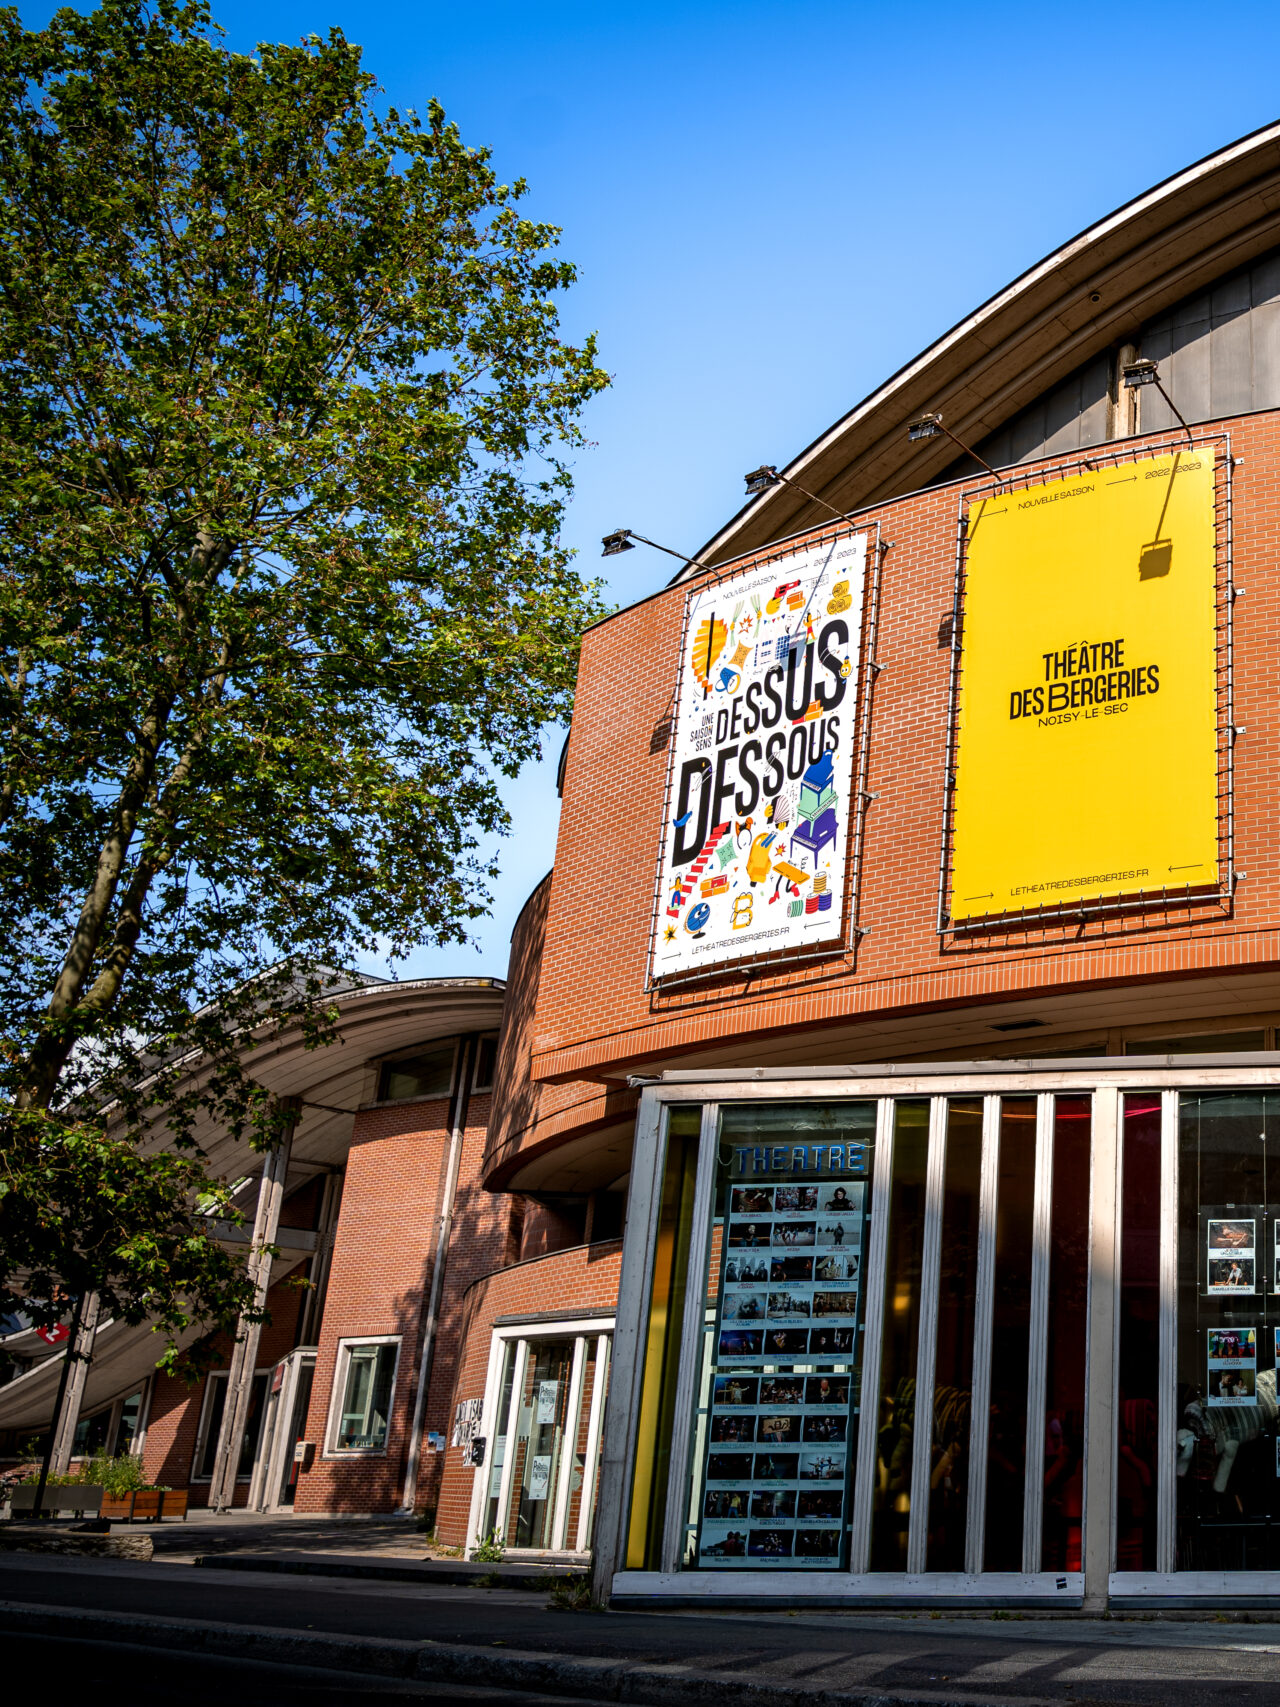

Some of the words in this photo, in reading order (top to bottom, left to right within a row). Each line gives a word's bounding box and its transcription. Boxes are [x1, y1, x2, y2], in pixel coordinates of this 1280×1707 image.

[1145, 467, 1170, 480] 2022
[1175, 462, 1201, 473] 2023
[1018, 493, 1059, 510] NOUVELLE
[1060, 485, 1095, 500] SAISON
[722, 584, 752, 600] NOUVELLE
[752, 574, 777, 588] SAISON
[1042, 638, 1124, 681] THÉÂTRE
[715, 619, 849, 745] DESSUS
[1010, 686, 1044, 720] DES
[1048, 664, 1159, 713] BERGERIES
[702, 712, 714, 726] UNE
[1038, 702, 1129, 728] NOISY-LE-SEC
[690, 725, 713, 742] SAISON
[696, 737, 712, 752] SENS
[671, 716, 841, 868] DESSOUS
[1010, 868, 1149, 896] LETHEATREDESBERGERIES.FR
[691, 927, 790, 955] LETHEATREDESBERGERIES.FR
[734, 1143, 866, 1175] THEATRE
